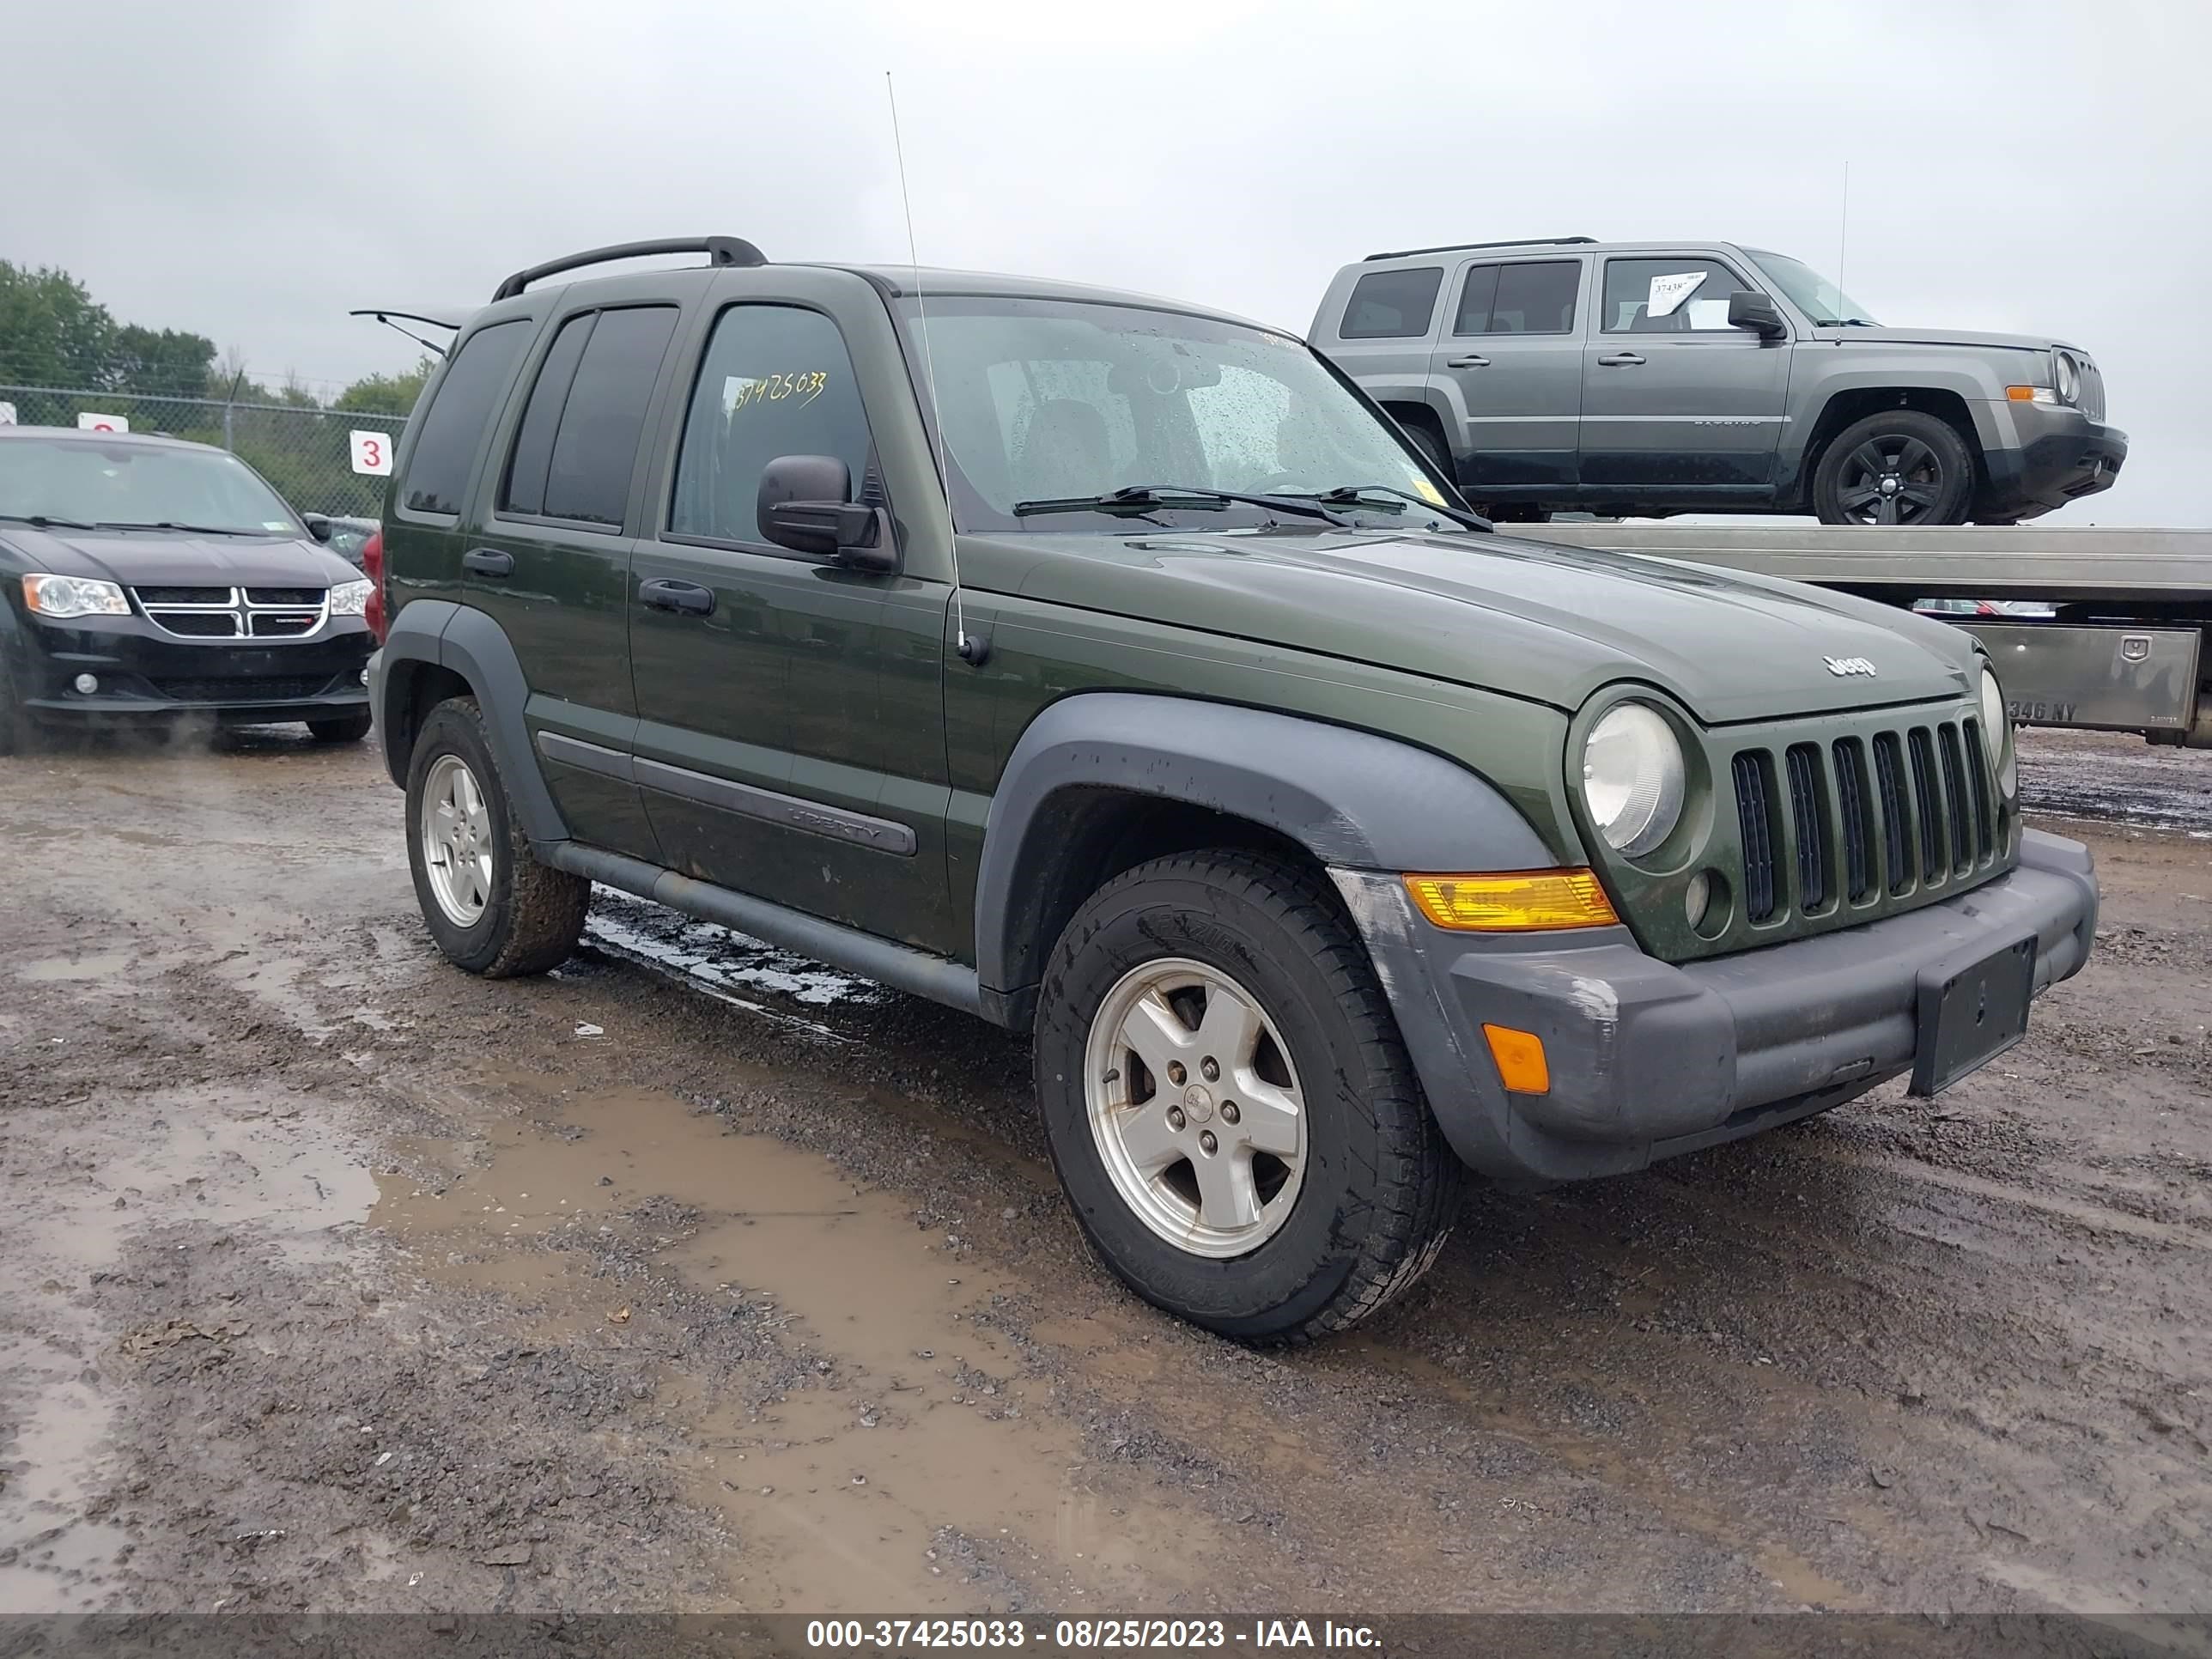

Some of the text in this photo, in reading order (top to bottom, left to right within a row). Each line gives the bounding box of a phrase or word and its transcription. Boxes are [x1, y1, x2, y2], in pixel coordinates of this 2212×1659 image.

[363, 441, 380, 466] 3
[1822, 655, 1876, 678] Jeep
[2052, 703, 2077, 722] NY
